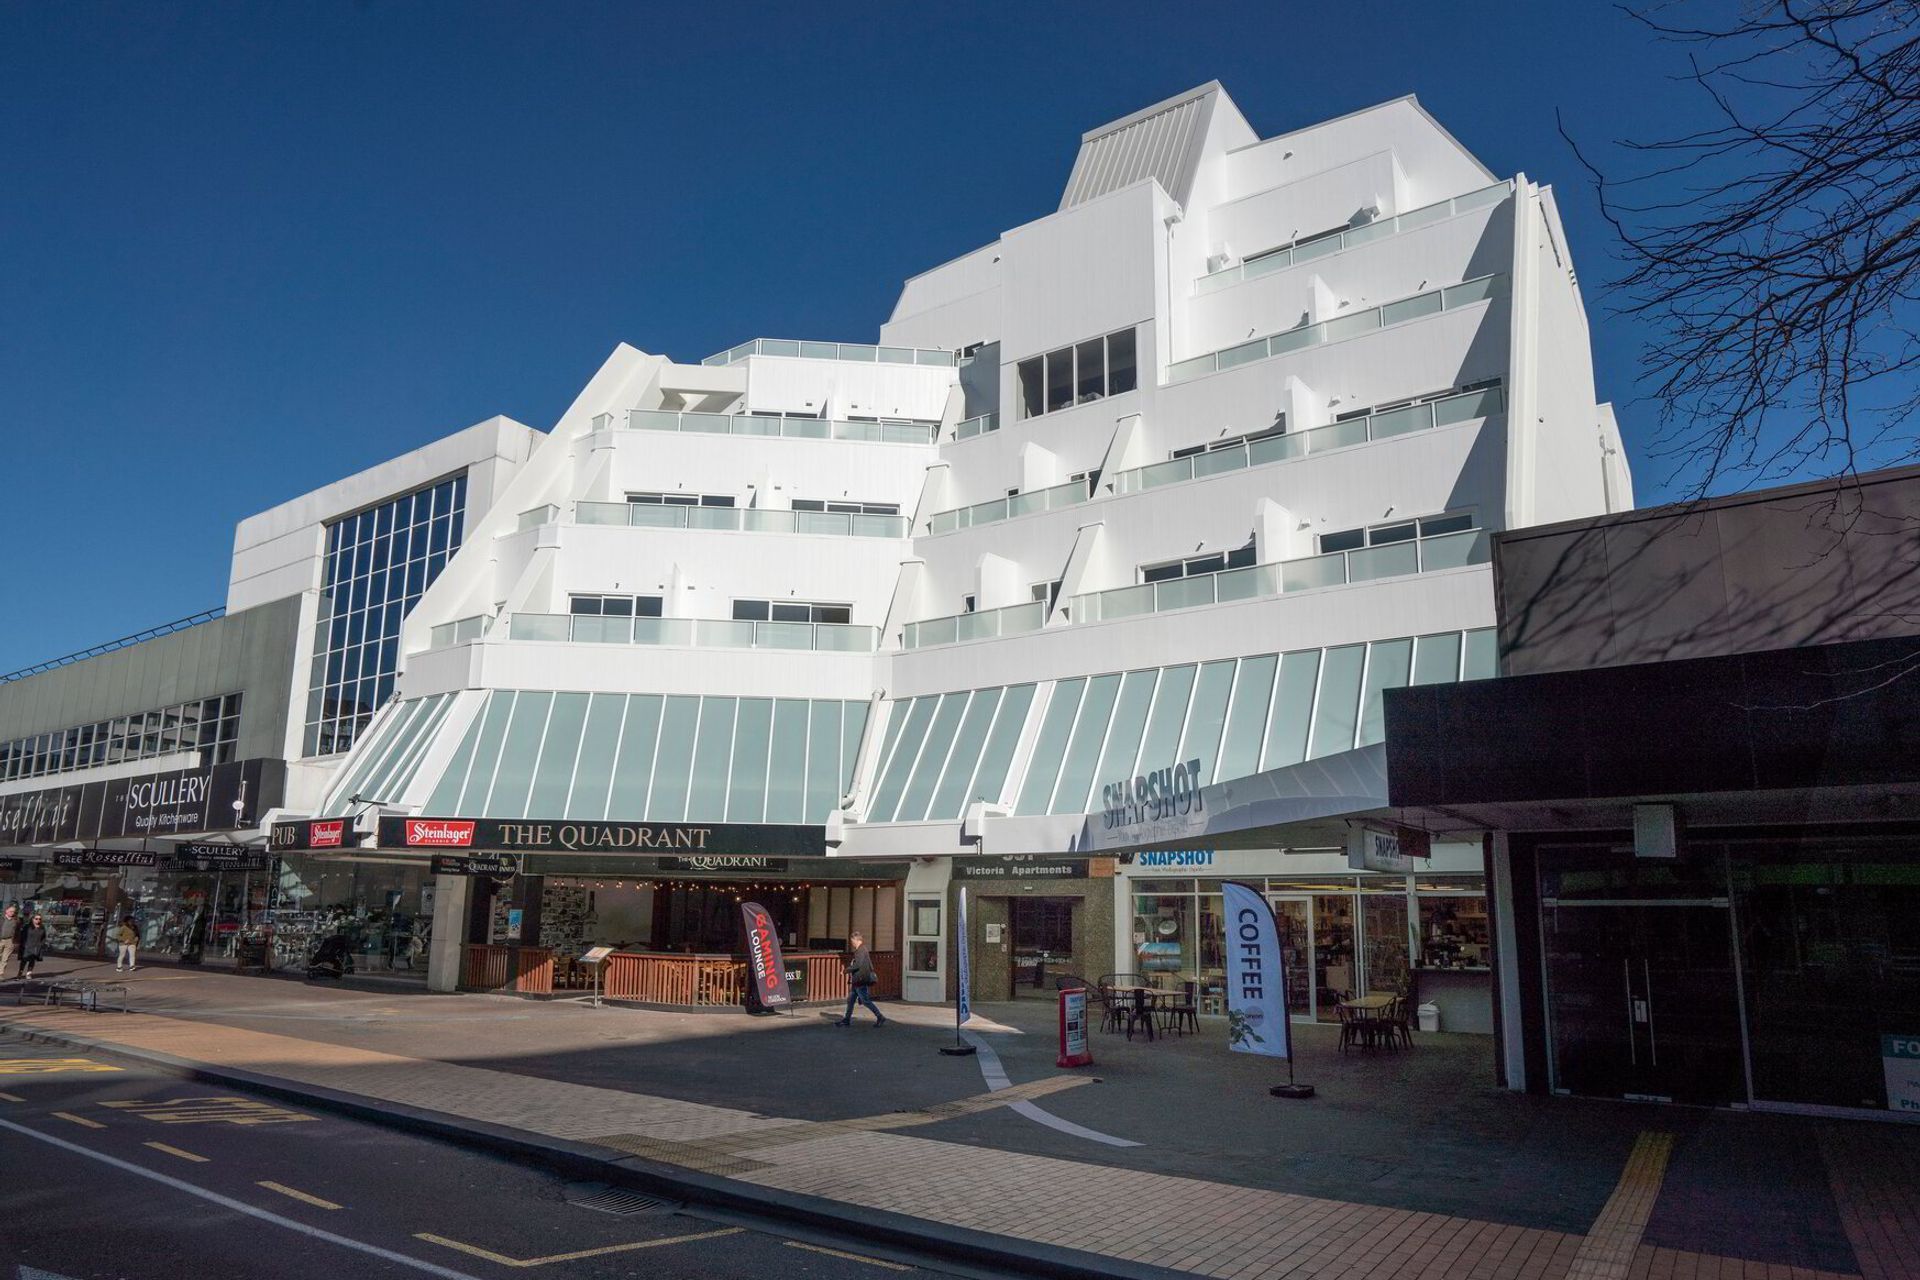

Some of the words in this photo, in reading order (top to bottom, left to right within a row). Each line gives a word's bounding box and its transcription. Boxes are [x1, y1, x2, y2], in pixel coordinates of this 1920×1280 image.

[129, 775, 210, 809] SCULLERY
[1103, 758, 1203, 830] SNAPSHOT
[158, 813, 199, 826] Kitchenware
[271, 826, 295, 846] PUB
[410, 823, 470, 843] Steinlager
[499, 824, 552, 845] THE
[559, 825, 711, 850] QUADRANT
[191, 845, 245, 856] SCULLERY
[1139, 850, 1215, 866] SNAPSHOT
[692, 856, 771, 870] QUADRANT
[966, 866, 1005, 875] Victoria
[1012, 866, 1073, 876] Apartments
[750, 928, 766, 979] LOUNGE
[756, 913, 778, 989] GAMING
[1238, 908, 1264, 1000] COFFEE
